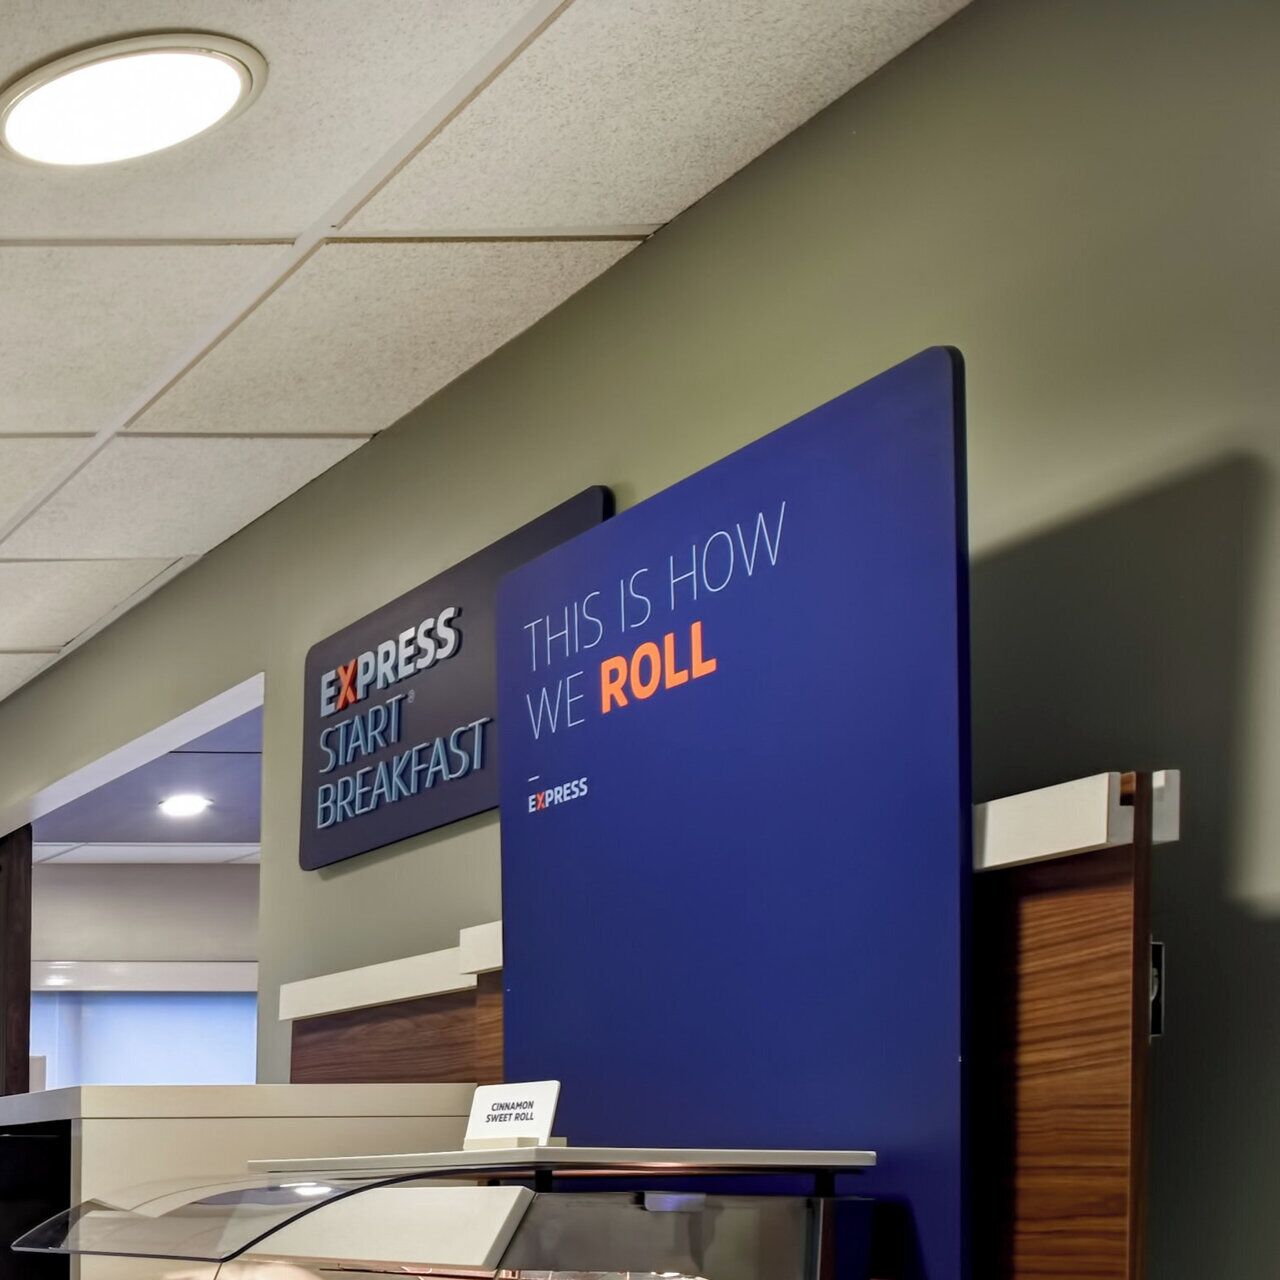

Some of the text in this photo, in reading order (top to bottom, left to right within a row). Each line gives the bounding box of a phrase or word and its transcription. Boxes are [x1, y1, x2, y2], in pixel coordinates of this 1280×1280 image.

[524, 500, 786, 672] THIS IS HOW
[320, 606, 456, 719] EXPRESS
[526, 620, 718, 740] WE ROLL
[317, 716, 491, 829] BREAKFAST
[528, 777, 589, 813] EXPRESS
[485, 1111, 535, 1123] SWEET ROLL
[491, 1100, 535, 1112] CINNAMON
